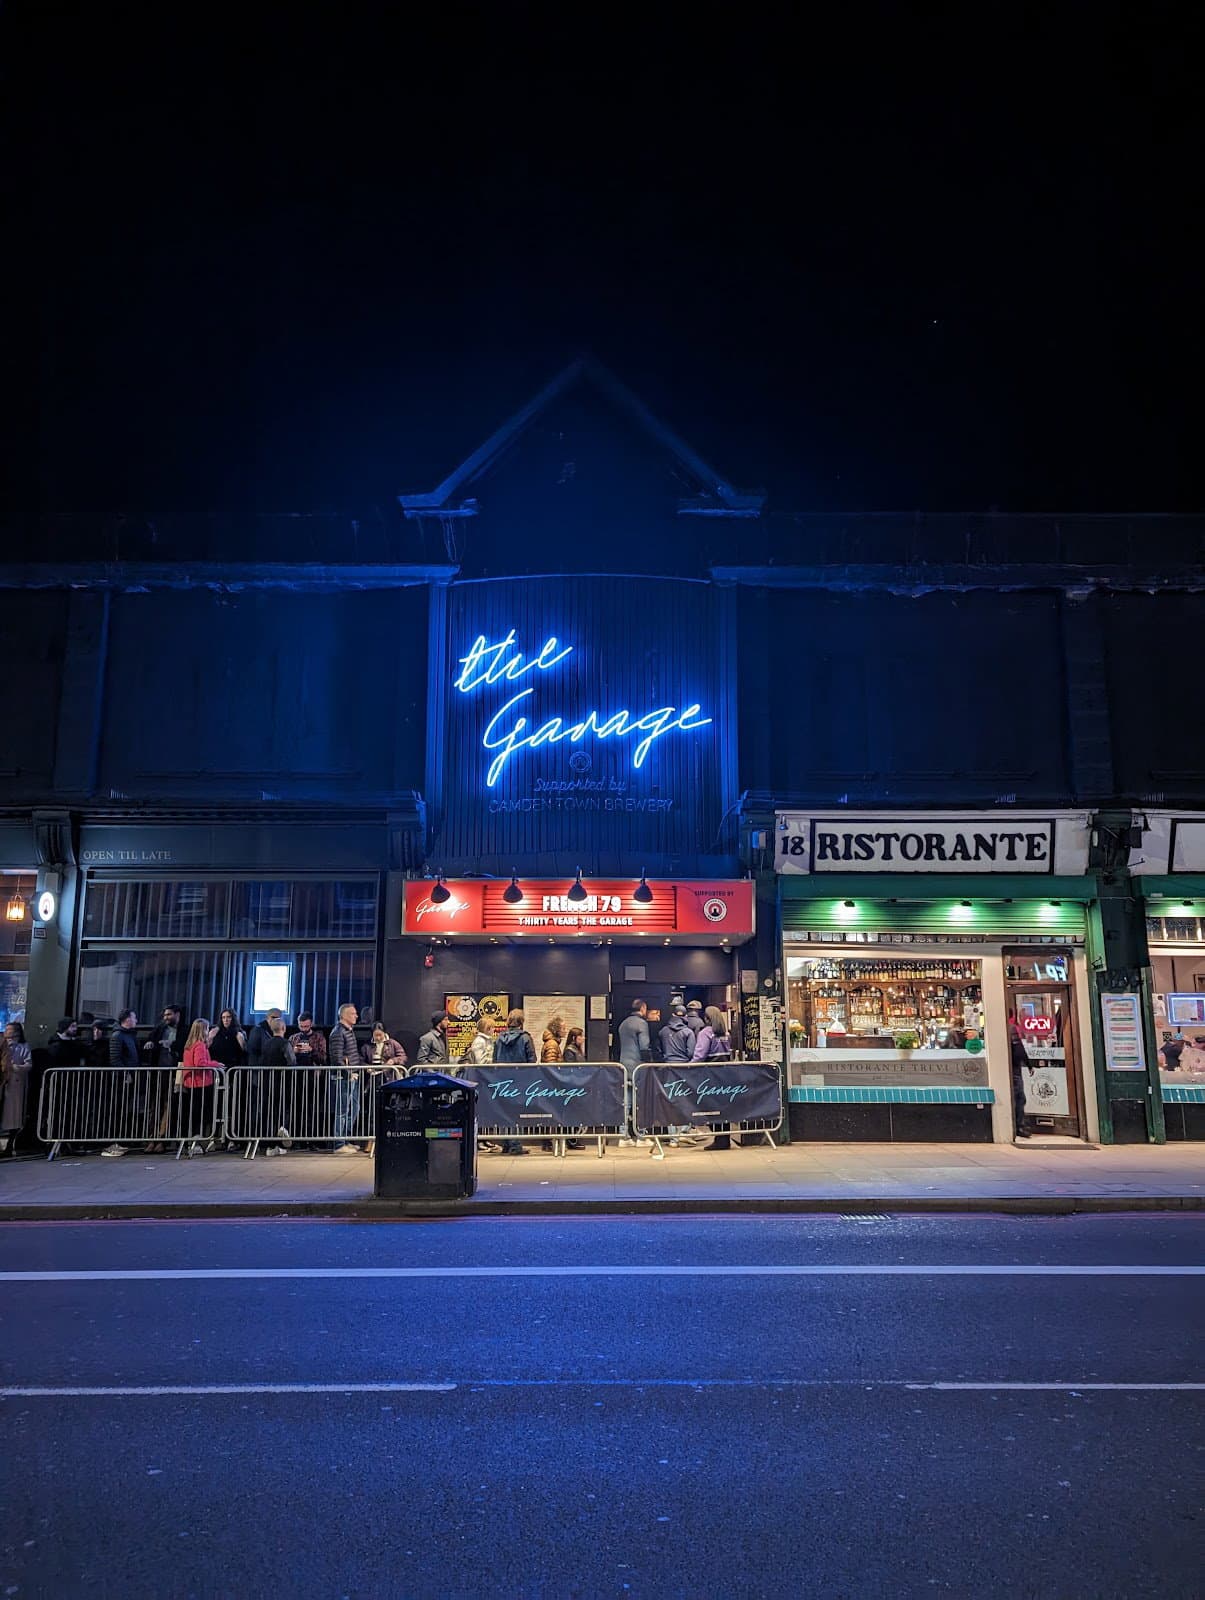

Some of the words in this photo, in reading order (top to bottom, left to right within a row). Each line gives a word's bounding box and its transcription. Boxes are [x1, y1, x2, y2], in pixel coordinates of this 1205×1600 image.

[454, 629, 573, 692] the
[483, 688, 712, 787] Garage
[534, 777, 604, 794] Supported
[608, 777, 626, 795] by
[489, 798, 550, 813] CAMDEN
[551, 797, 599, 811] TOWN
[604, 798, 673, 812] BREWERY
[83, 850, 114, 860] OPEN
[118, 850, 137, 860] TIL
[141, 850, 171, 860] LATE
[781, 835, 805, 856] 18
[817, 832, 1047, 861] RISTORANTE
[415, 897, 471, 922] Gage
[542, 896, 598, 912] FRENCH
[518, 916, 549, 926] THIRTY
[552, 916, 578, 926] YEARS
[581, 916, 597, 926] THE
[599, 916, 633, 926] GARAGE
[1024, 1018, 1051, 1030] OPEN
[488, 1079, 520, 1100] The
[525, 1079, 587, 1107] Garage
[664, 1079, 693, 1100] The
[696, 1078, 749, 1105] Garage
